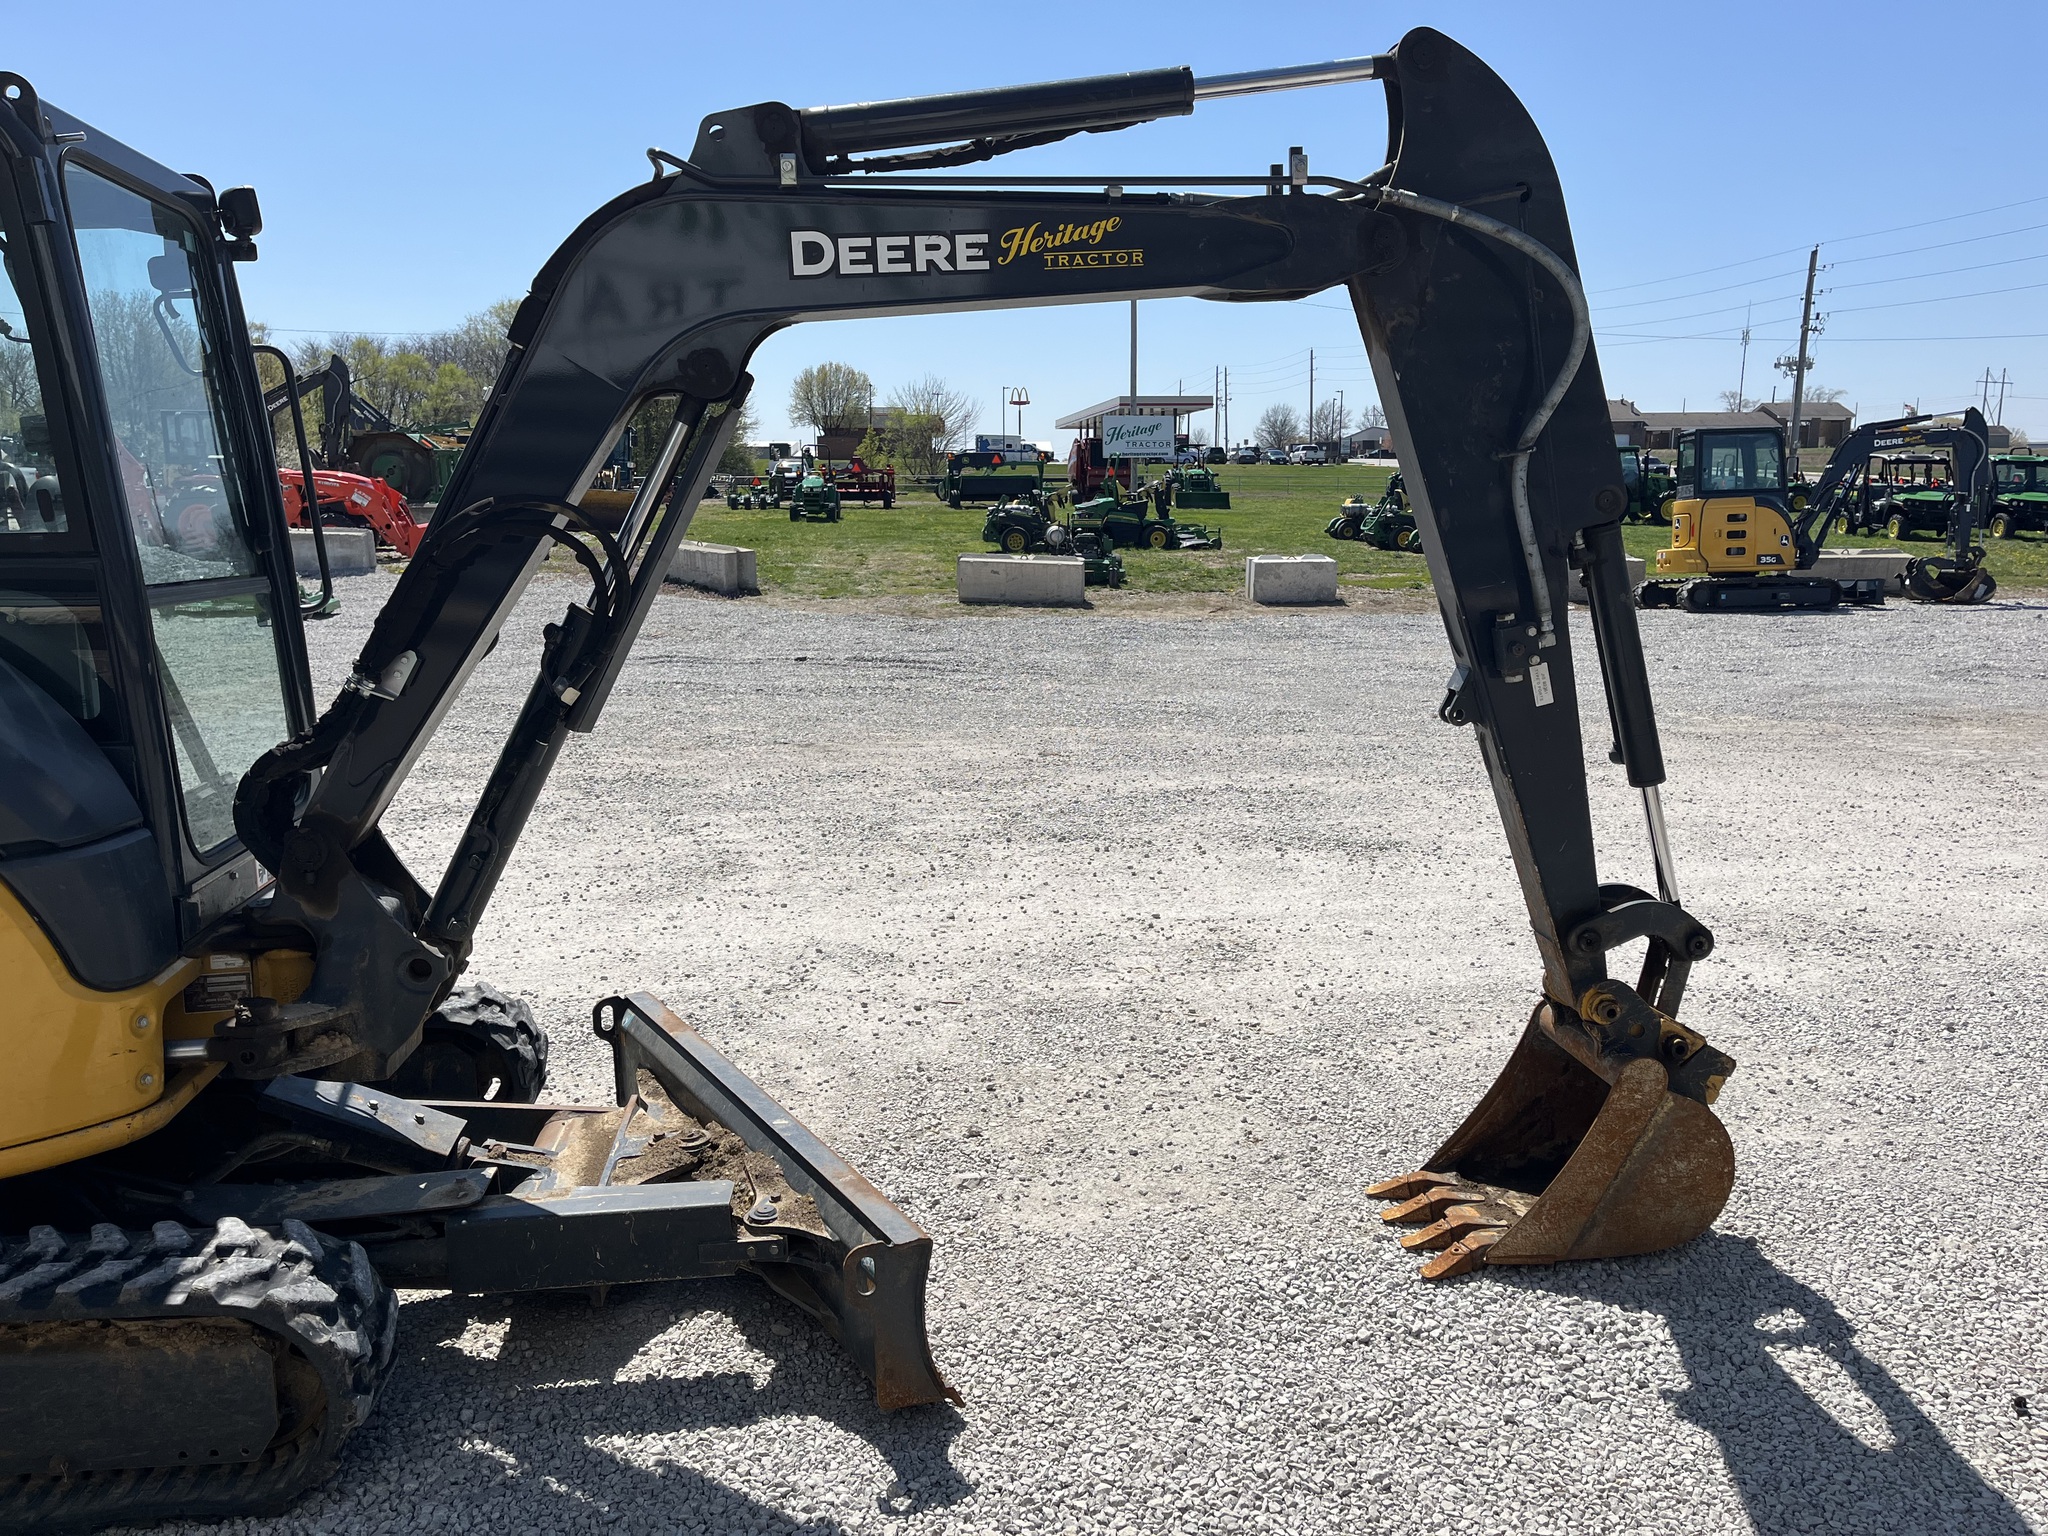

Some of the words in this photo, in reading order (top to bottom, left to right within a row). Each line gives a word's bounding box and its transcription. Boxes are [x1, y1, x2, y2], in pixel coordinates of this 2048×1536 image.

[997, 216, 1123, 264] Heritage
[790, 231, 990, 276] DEERE
[1044, 253, 1144, 267] TRACTOR
[267, 395, 289, 411] DEERE
[1105, 422, 1162, 445] Heritage
[1873, 437, 1904, 447] DEERE
[1760, 556, 1777, 564] 35G
